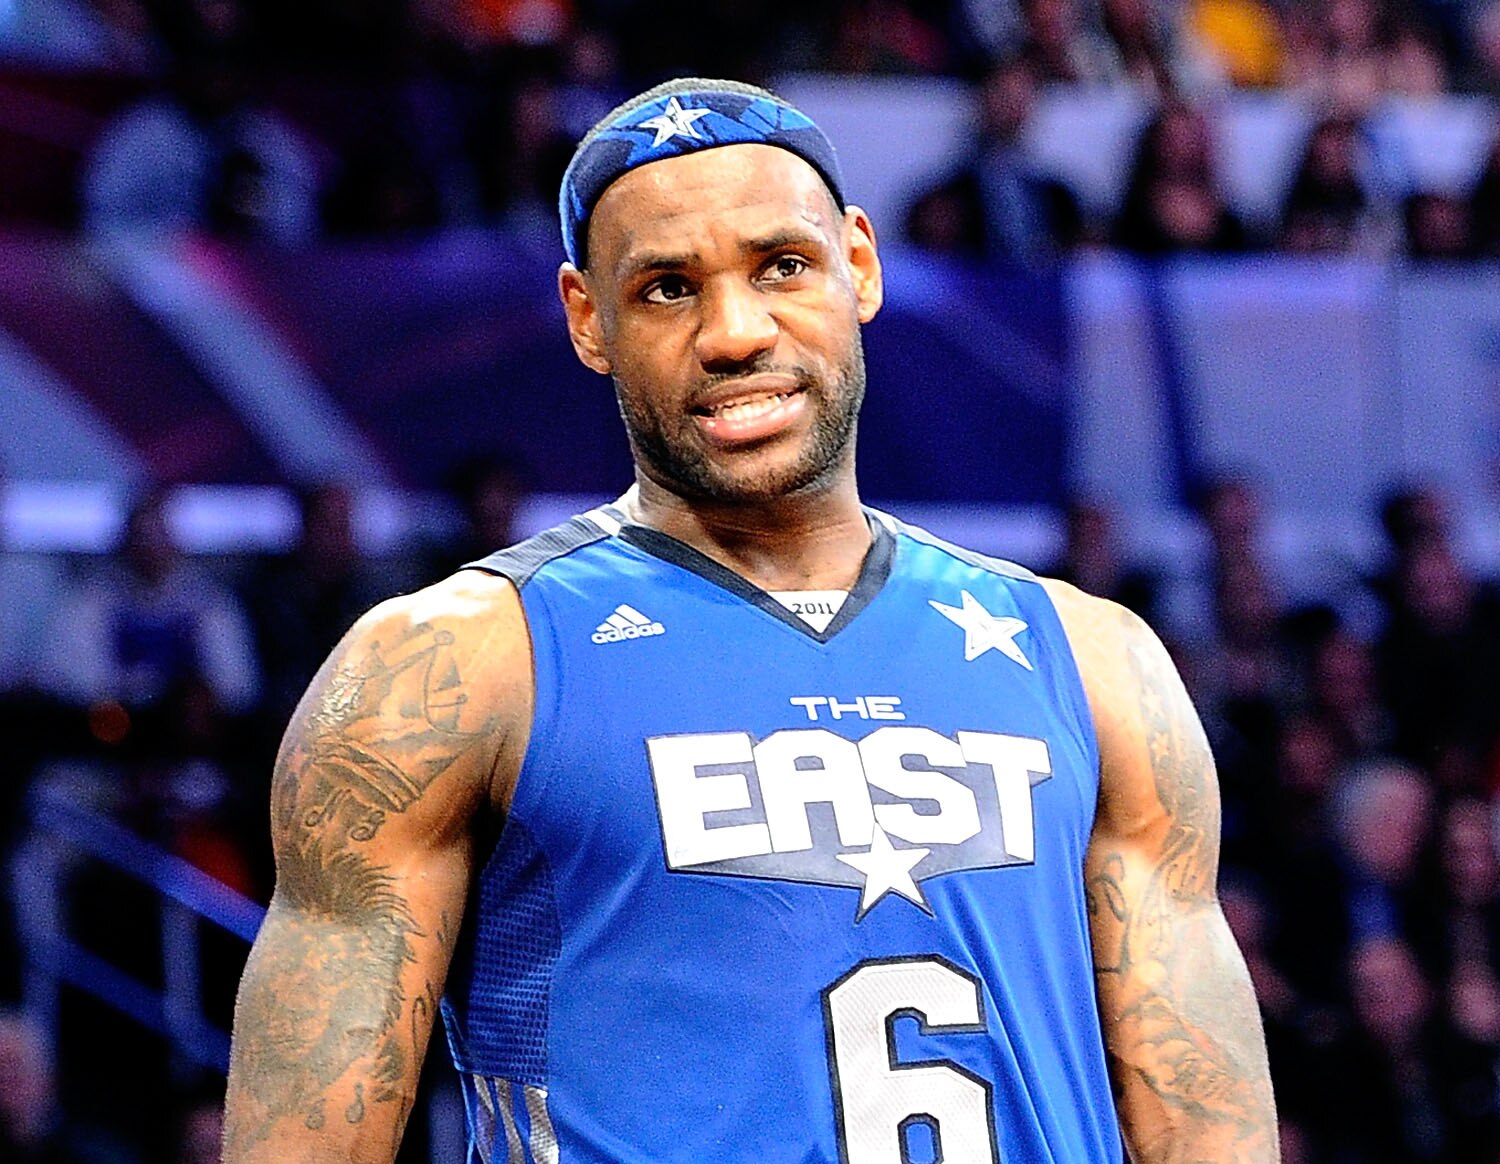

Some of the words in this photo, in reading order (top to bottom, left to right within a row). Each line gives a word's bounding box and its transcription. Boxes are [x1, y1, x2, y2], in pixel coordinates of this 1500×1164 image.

[792, 602, 835, 616] 2011
[591, 622, 665, 645] adidas
[790, 696, 905, 720] THE
[645, 726, 1052, 869] EAST
